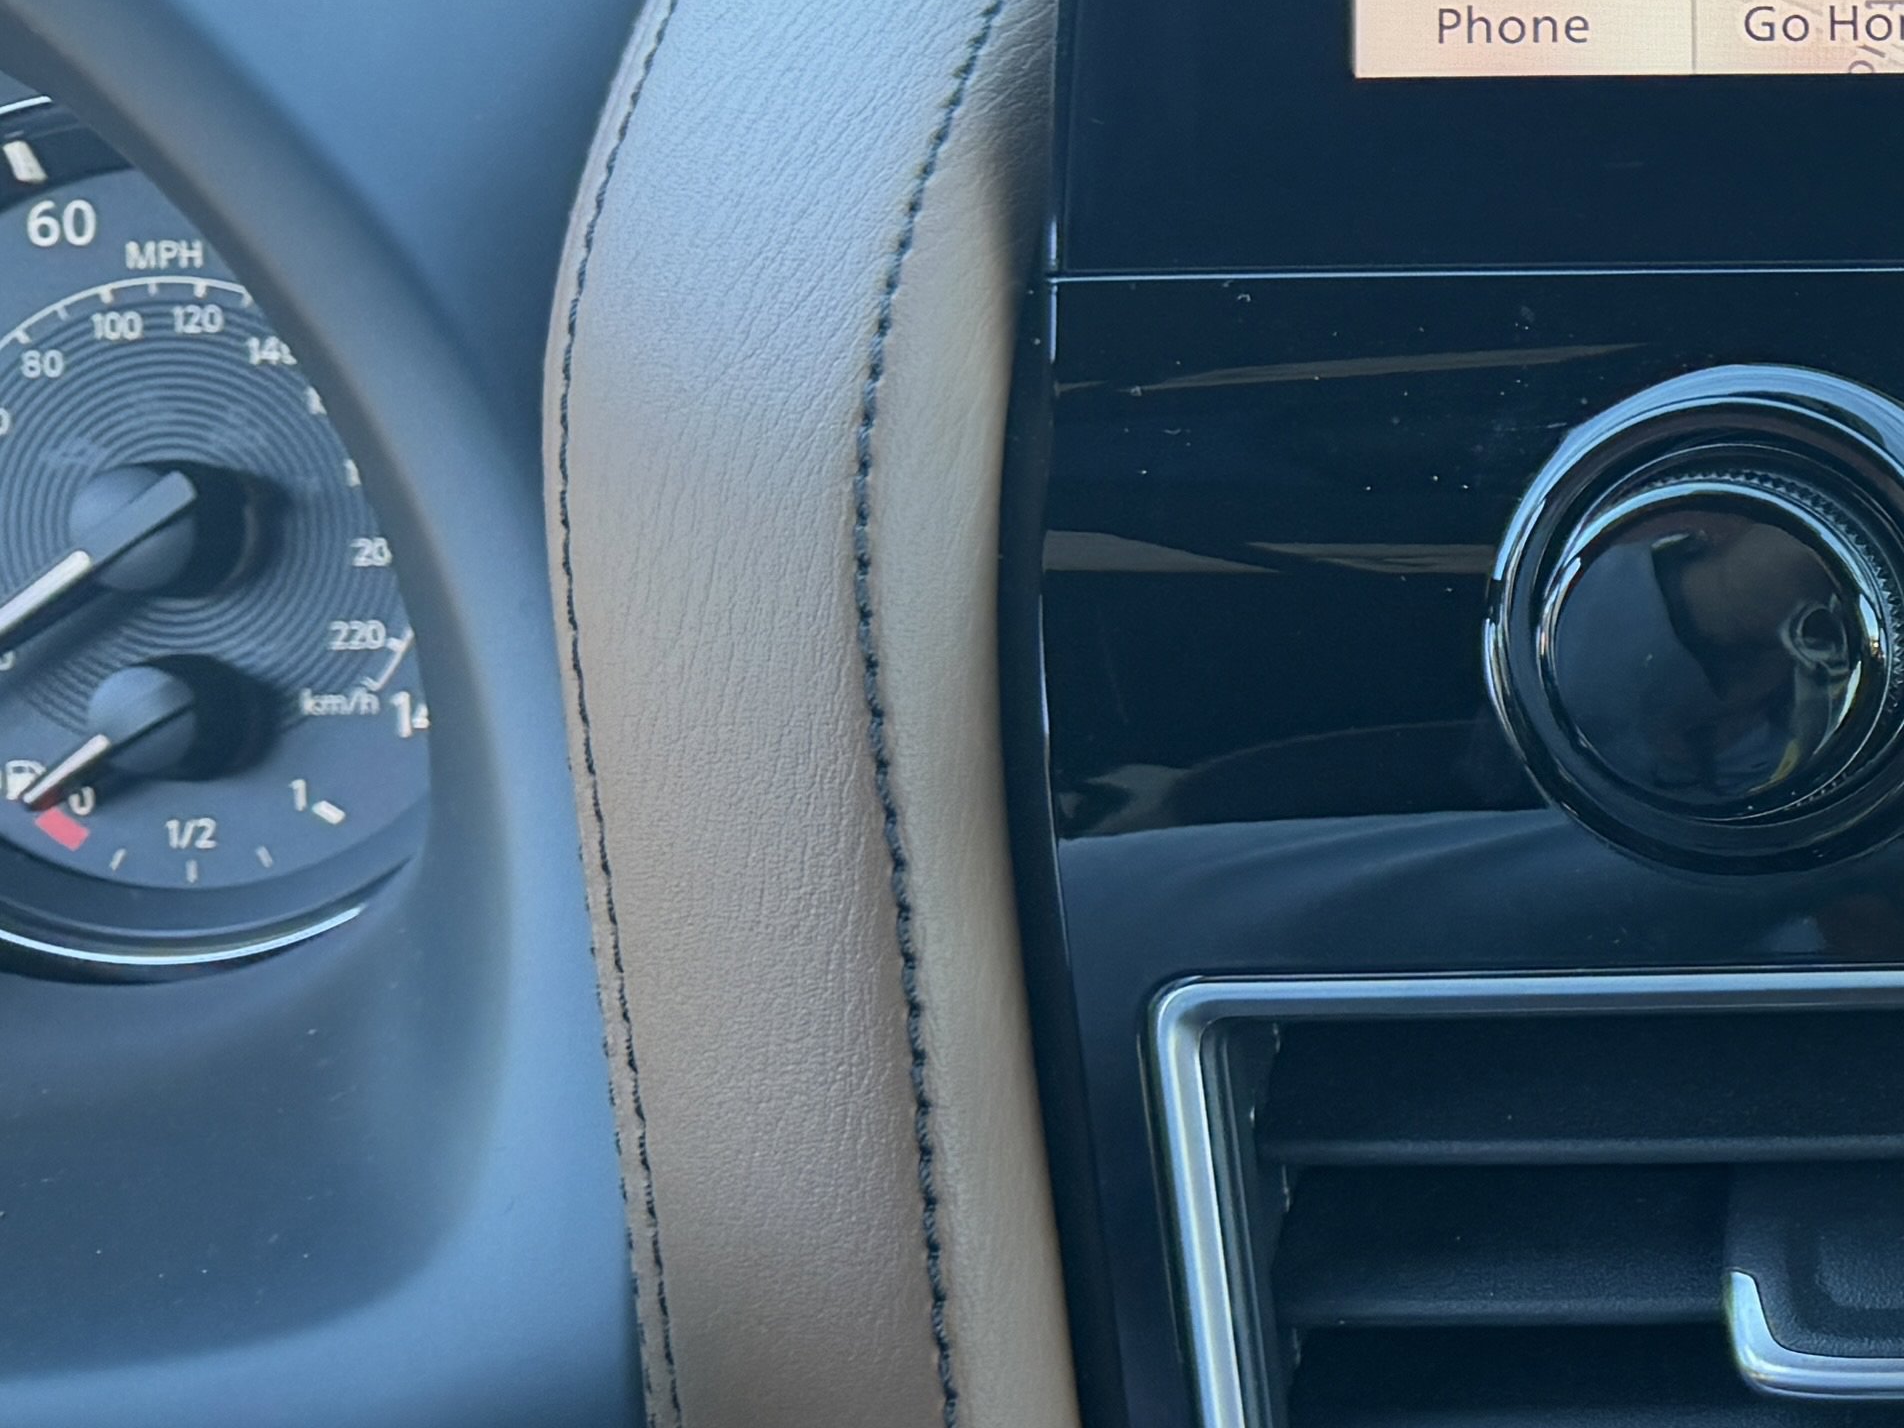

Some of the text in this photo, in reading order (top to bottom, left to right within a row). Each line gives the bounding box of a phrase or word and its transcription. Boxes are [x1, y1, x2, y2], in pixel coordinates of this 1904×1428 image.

[1437, 5, 1590, 45] Phone
[1743, 5, 1810, 43] Go
[26, 198, 97, 247] 60
[124, 239, 203, 270] MPH
[91, 310, 144, 341] 100
[172, 304, 225, 335] 120
[20, 350, 65, 379] 80
[328, 620, 387, 650] 220
[165, 816, 219, 851] 1/2
